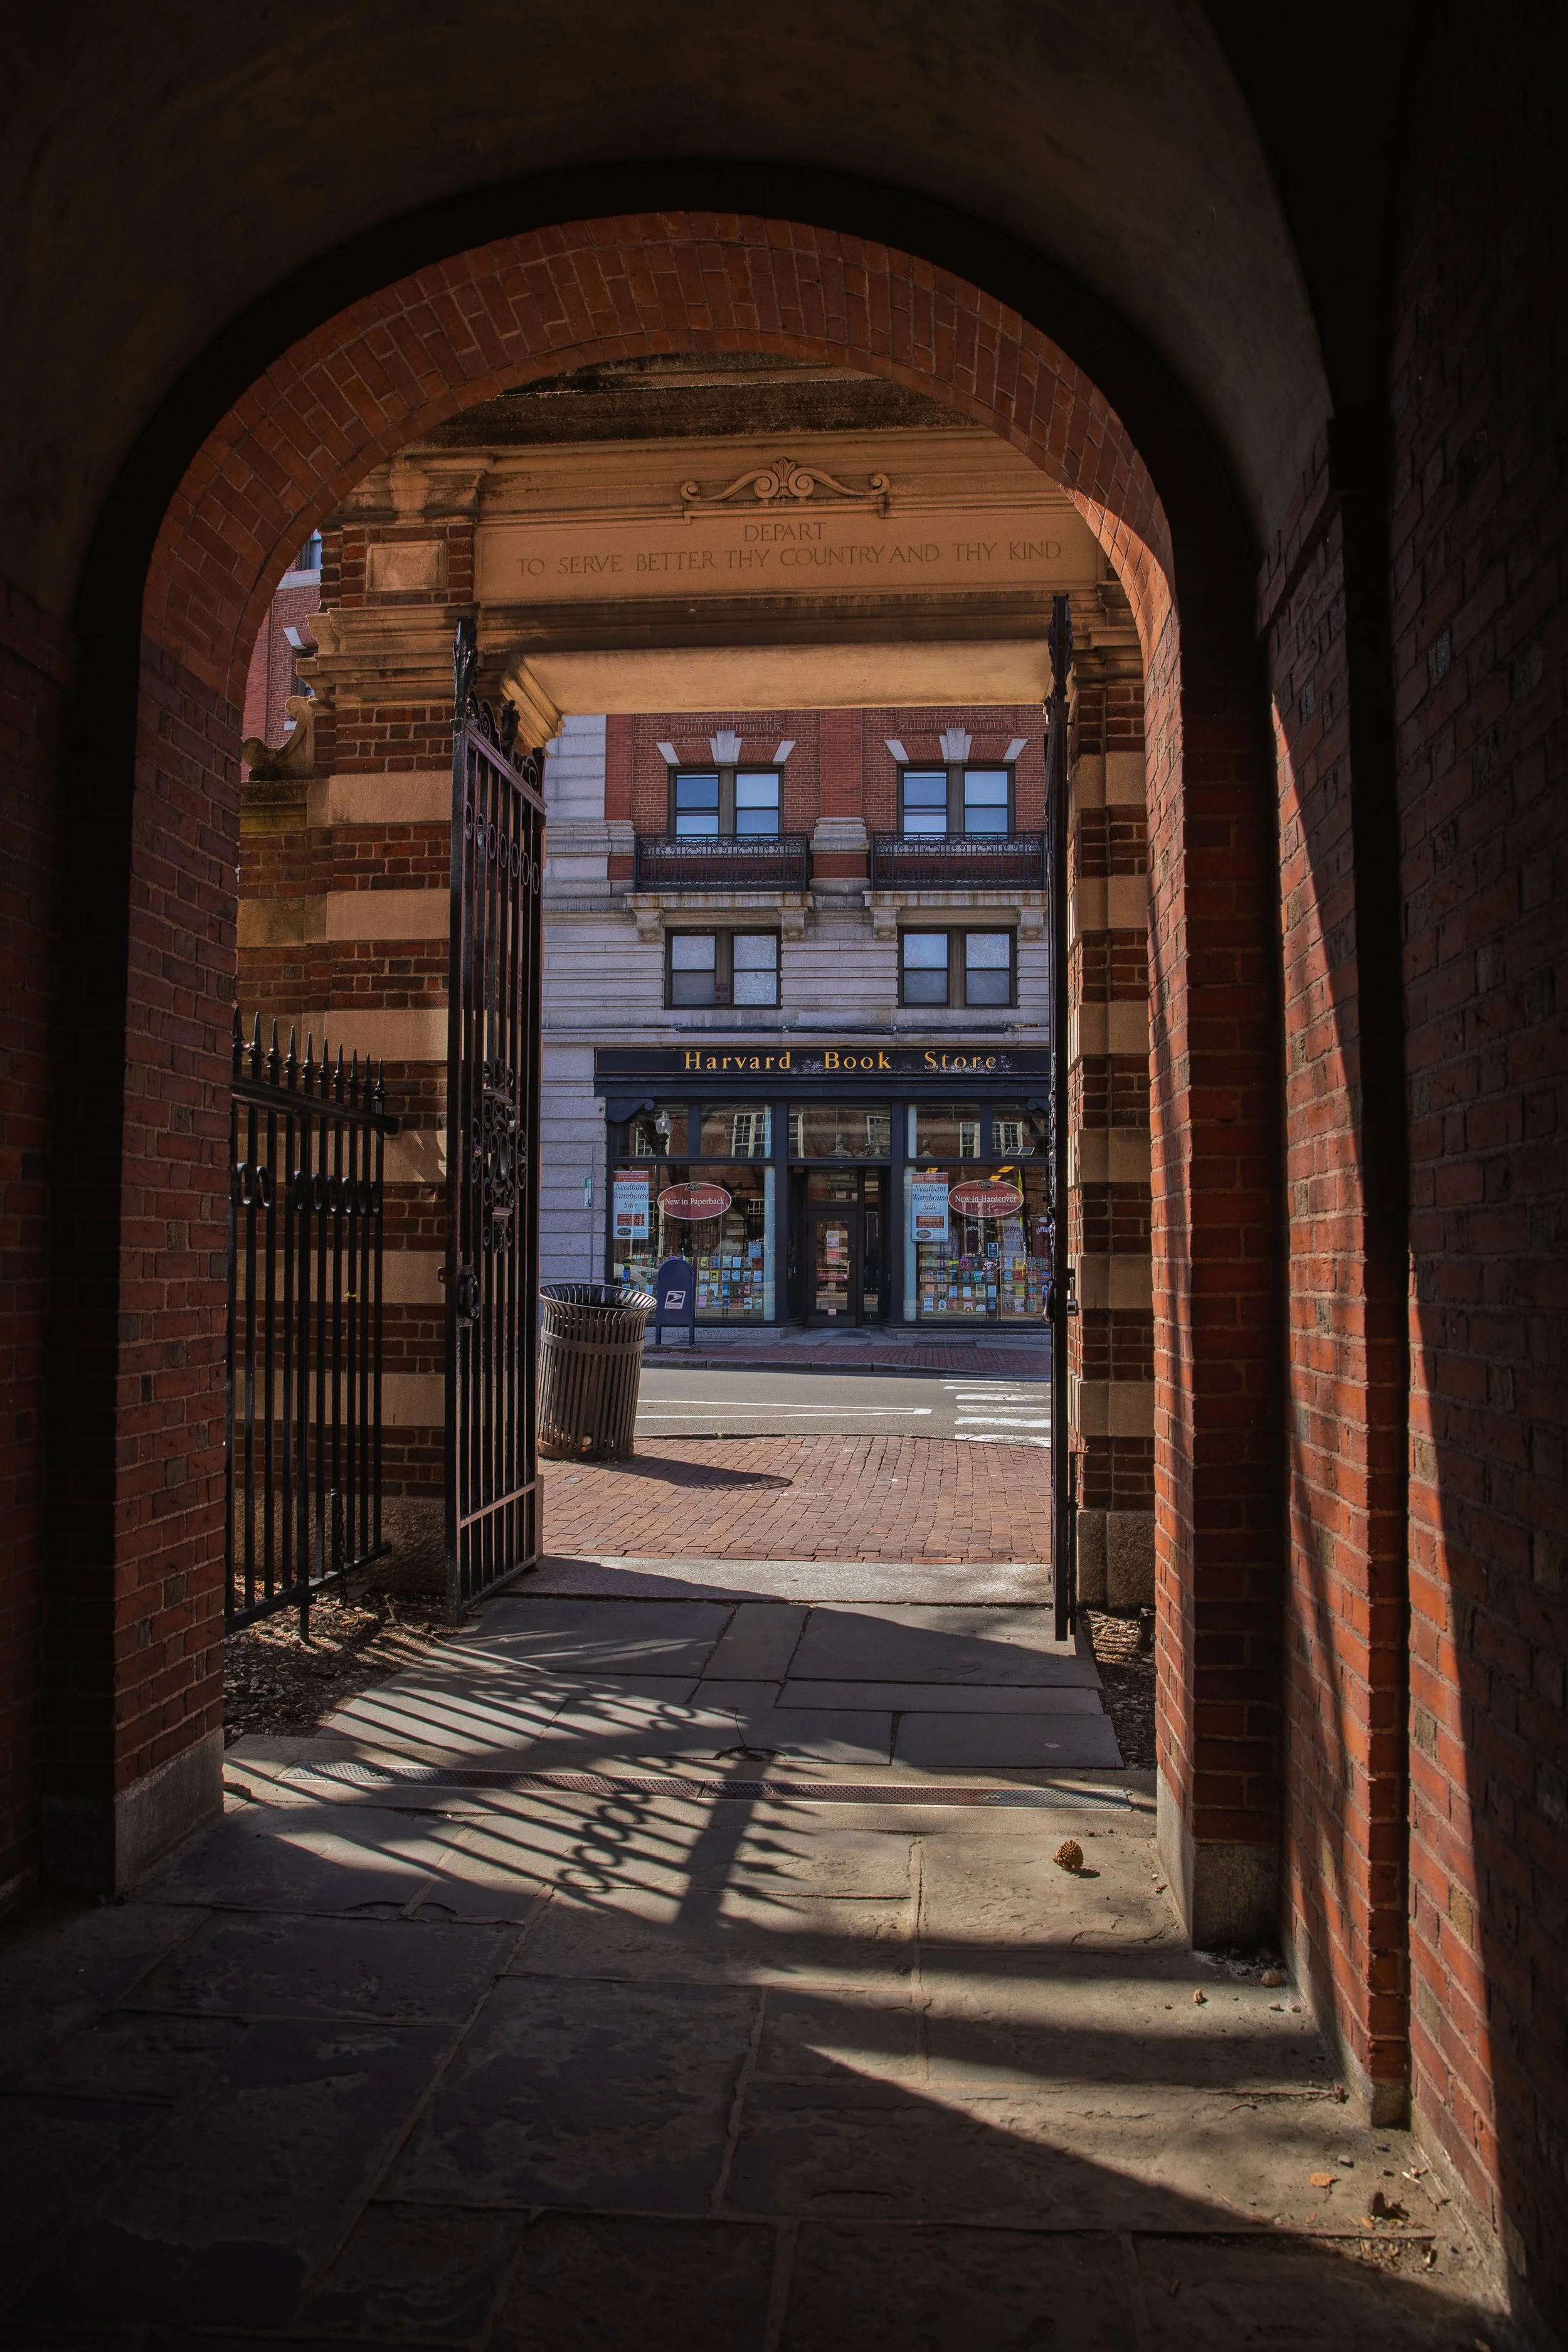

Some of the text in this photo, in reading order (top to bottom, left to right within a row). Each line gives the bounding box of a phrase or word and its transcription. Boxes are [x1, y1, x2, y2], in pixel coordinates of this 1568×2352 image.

[743, 522, 826, 543] DEPART
[517, 540, 1061, 576] TO SERVE BETTER THY COUNTRY AND THY KIND
[684, 1050, 998, 1070] Harvard Book Store
[615, 1183, 647, 1191] Needham
[691, 1197, 724, 1207] Paperback
[982, 1195, 1017, 1203] Hardcover
